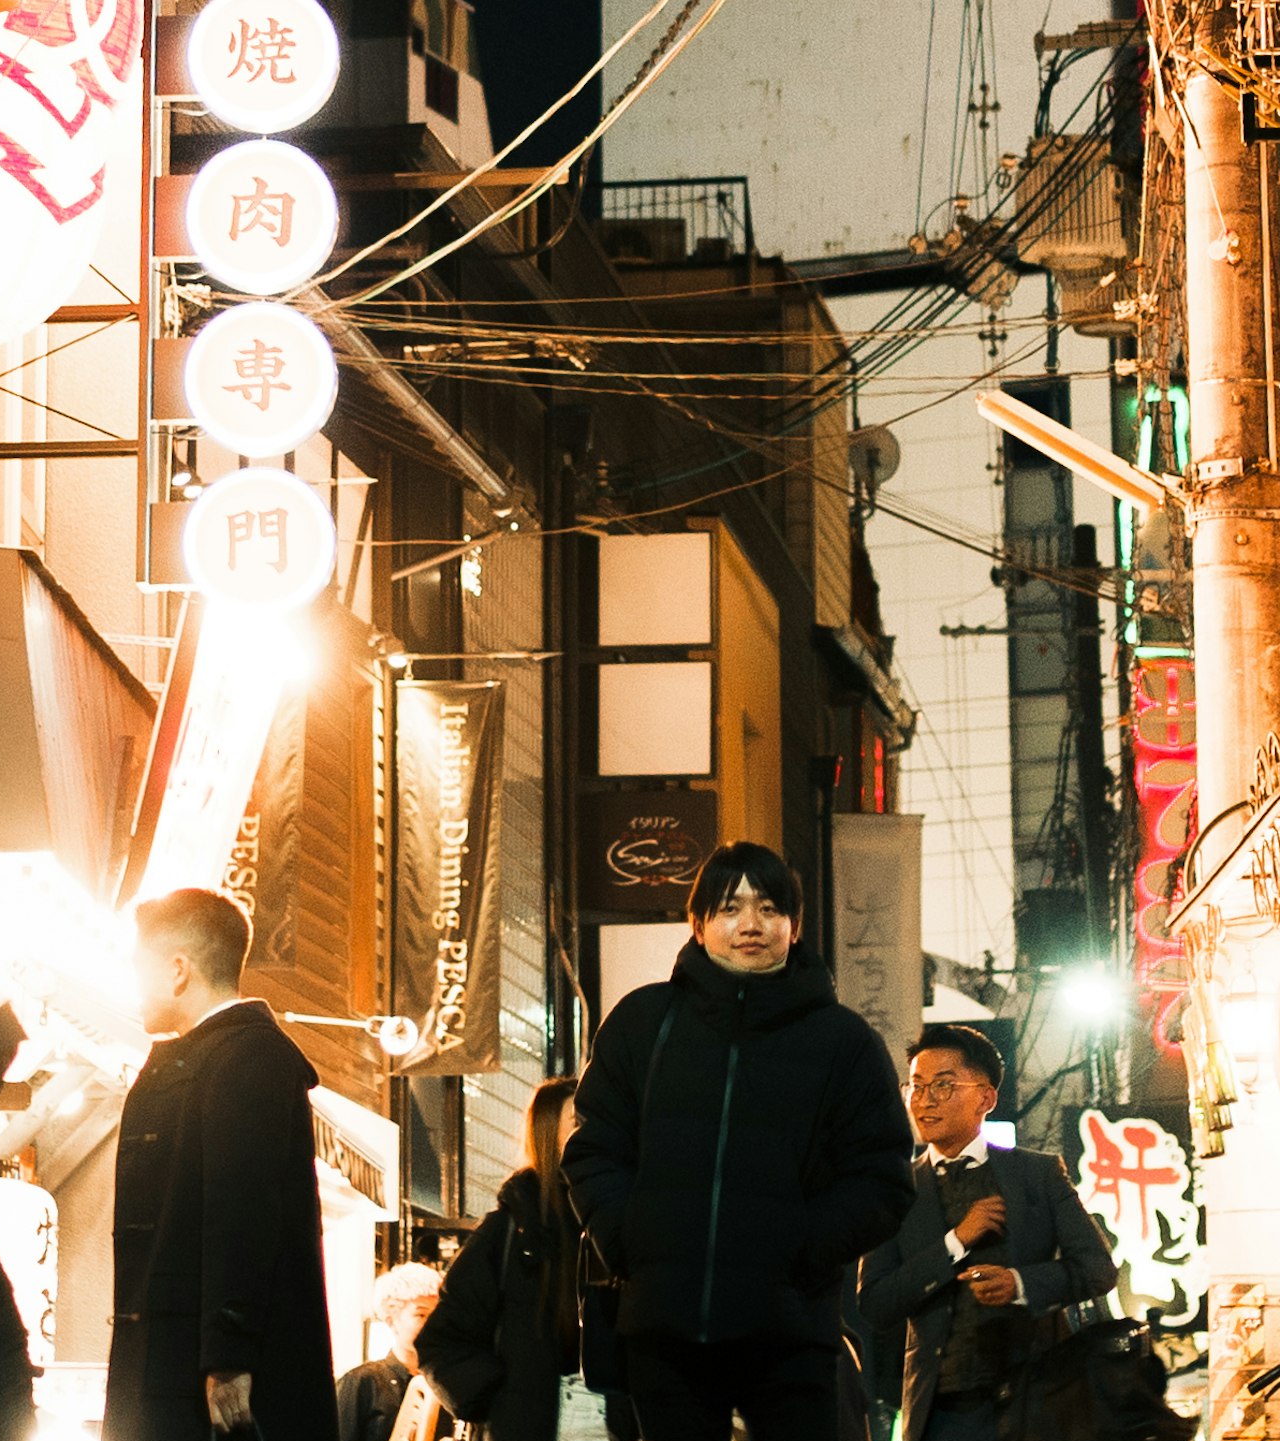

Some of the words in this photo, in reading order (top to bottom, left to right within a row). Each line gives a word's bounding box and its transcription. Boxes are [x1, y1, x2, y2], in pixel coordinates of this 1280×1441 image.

[439, 702, 469, 809] Italian
[432, 817, 469, 930] Dining
[435, 937, 468, 1055] PESCA
